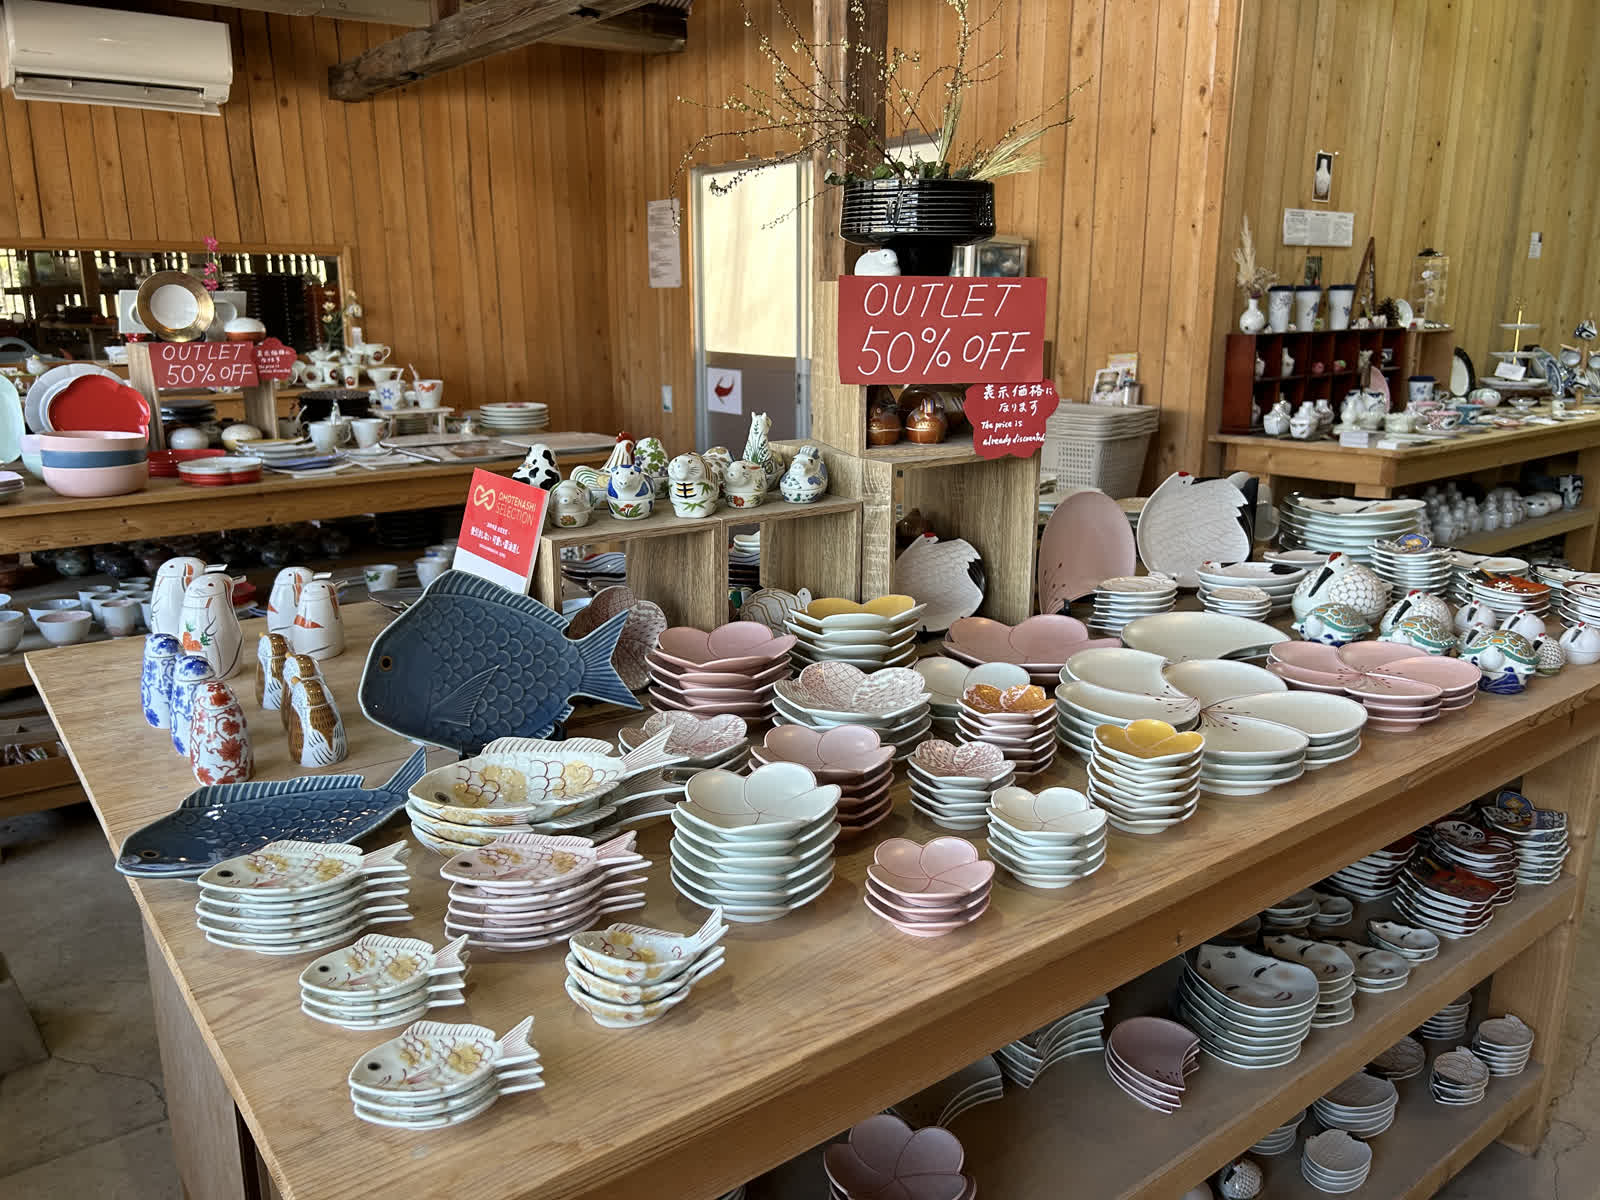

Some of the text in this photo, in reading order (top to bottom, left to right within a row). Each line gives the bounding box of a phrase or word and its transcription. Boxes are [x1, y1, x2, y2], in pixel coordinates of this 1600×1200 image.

[863, 282, 1022, 318] OUTLET
[162, 344, 246, 361] OUTLET
[857, 326, 1031, 376] 50% OFF
[167, 363, 254, 385] 50% OFF
[983, 383, 1053, 401] 表示価格に
[998, 400, 1038, 417] なります
[994, 421, 1013, 432] price
[982, 434, 1012, 446] already
[498, 492, 537, 512] OMOTENASHI
[495, 502, 535, 526] SELECTION
